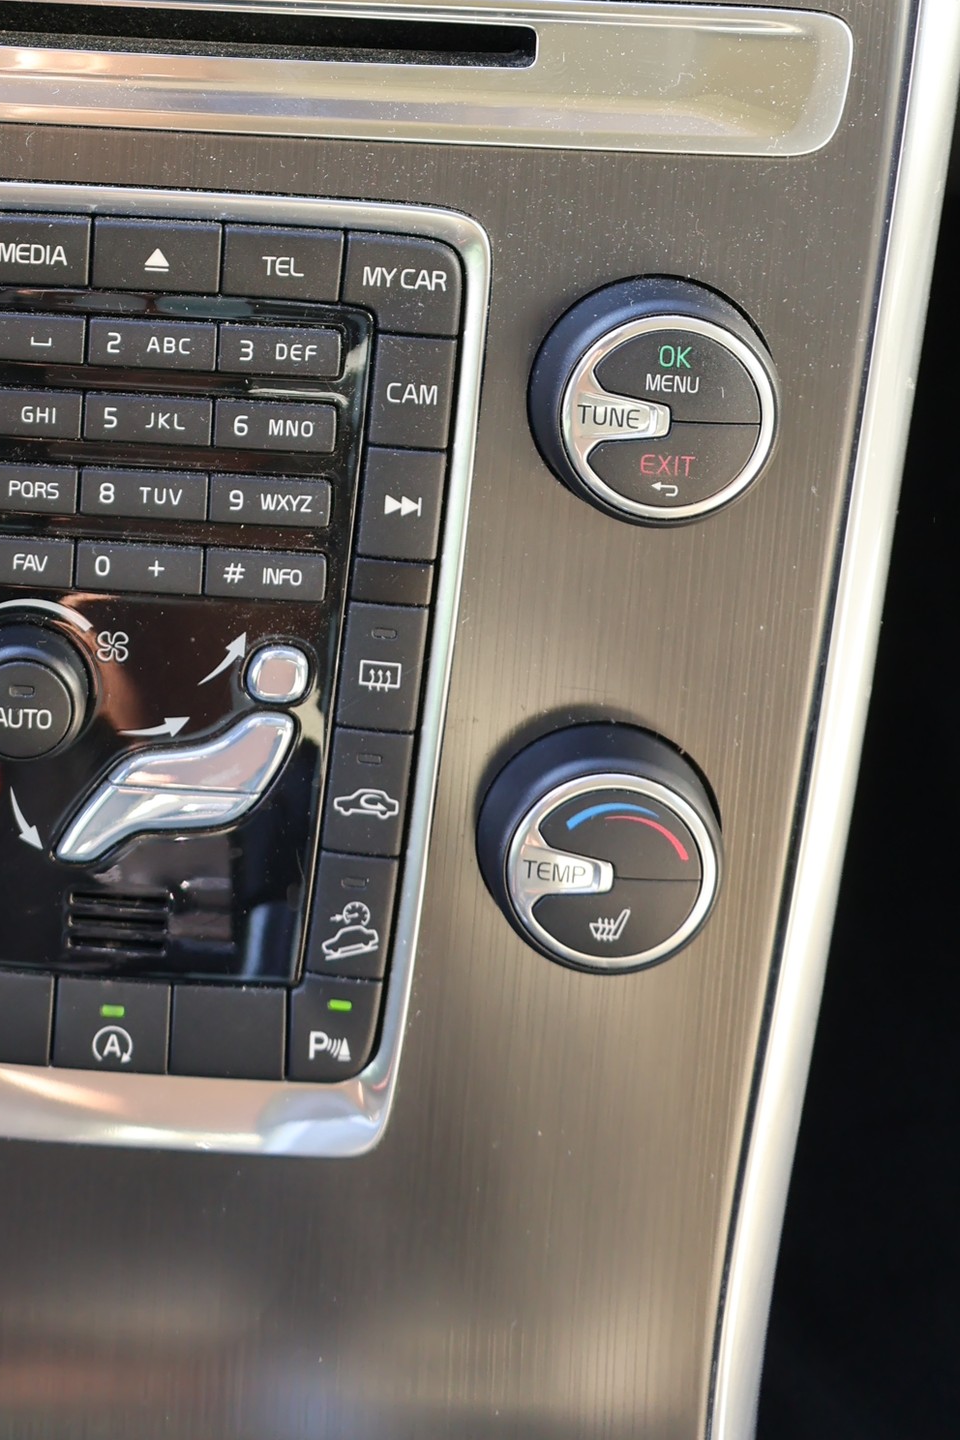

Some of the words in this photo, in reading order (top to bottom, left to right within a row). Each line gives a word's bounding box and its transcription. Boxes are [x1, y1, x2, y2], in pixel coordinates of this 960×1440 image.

[262, 256, 305, 278] TEL
[362, 266, 397, 288] MY
[400, 268, 448, 292] CAR
[106, 332, 122, 353] 2
[146, 336, 191, 355] ABC
[240, 340, 254, 361] 3
[275, 343, 318, 361] DEF
[659, 345, 693, 369] OK
[386, 382, 439, 406] CAM
[645, 373, 700, 394] MENU
[21, 406, 57, 425] GHI
[103, 407, 118, 428] 5
[145, 412, 186, 431] JKL
[233, 415, 249, 436] 6
[268, 419, 315, 438] MNO
[577, 404, 641, 429] TUNE
[640, 454, 696, 477] EXIT
[8, 480, 60, 499] PQRS
[98, 482, 115, 504] 8
[139, 487, 183, 506] TUV
[228, 490, 245, 511] 9
[260, 493, 313, 513] WXYZ
[12, 553, 49, 572] FAV
[262, 567, 303, 586] INFO
[522, 859, 586, 883] TEMP
